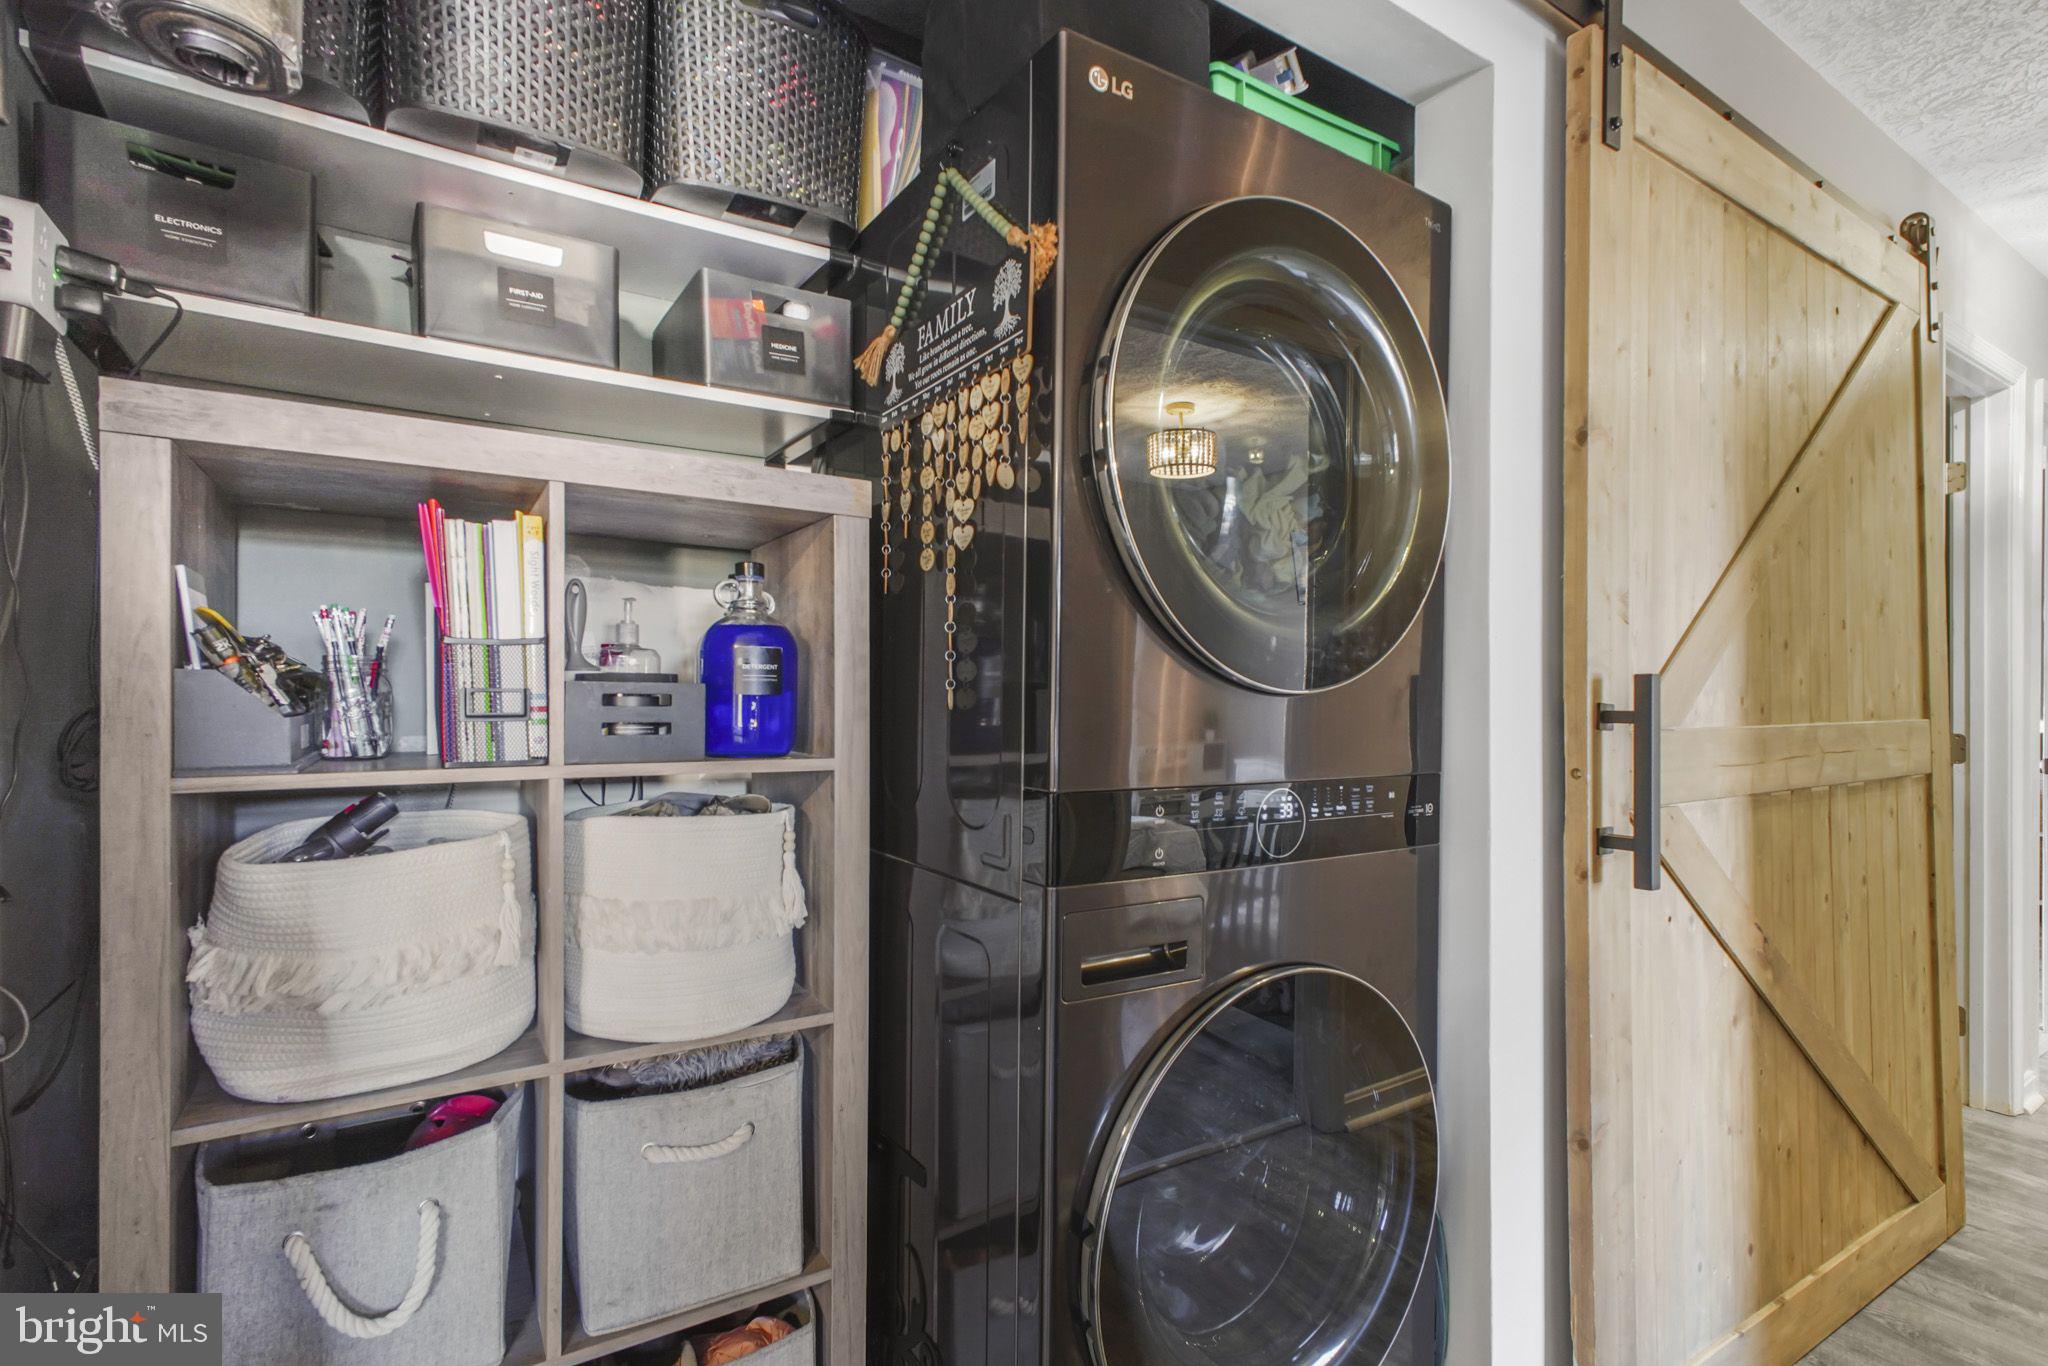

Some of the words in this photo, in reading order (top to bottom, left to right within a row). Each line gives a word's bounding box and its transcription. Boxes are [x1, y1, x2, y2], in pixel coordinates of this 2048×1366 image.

[1112, 76, 1133, 100] LG
[154, 213, 223, 235] ELECTRONICS
[508, 286, 544, 300] FIRST-AID
[917, 288, 977, 351] FAMILY
[919, 351, 930, 364] Like
[930, 338, 950, 357] branches
[951, 333, 958, 343] on
[1014, 336, 1024, 346] Dec
[908, 372, 915, 382] We
[922, 362, 932, 376] grow
[933, 357, 938, 367] in
[938, 344, 959, 364] different
[959, 327, 987, 350] directions,
[914, 380, 922, 390] Yet
[922, 376, 930, 386] our
[930, 368, 942, 382] roots
[942, 357, 960, 373] remain
[960, 354, 965, 362] as
[742, 663, 778, 671] DETERGENT
